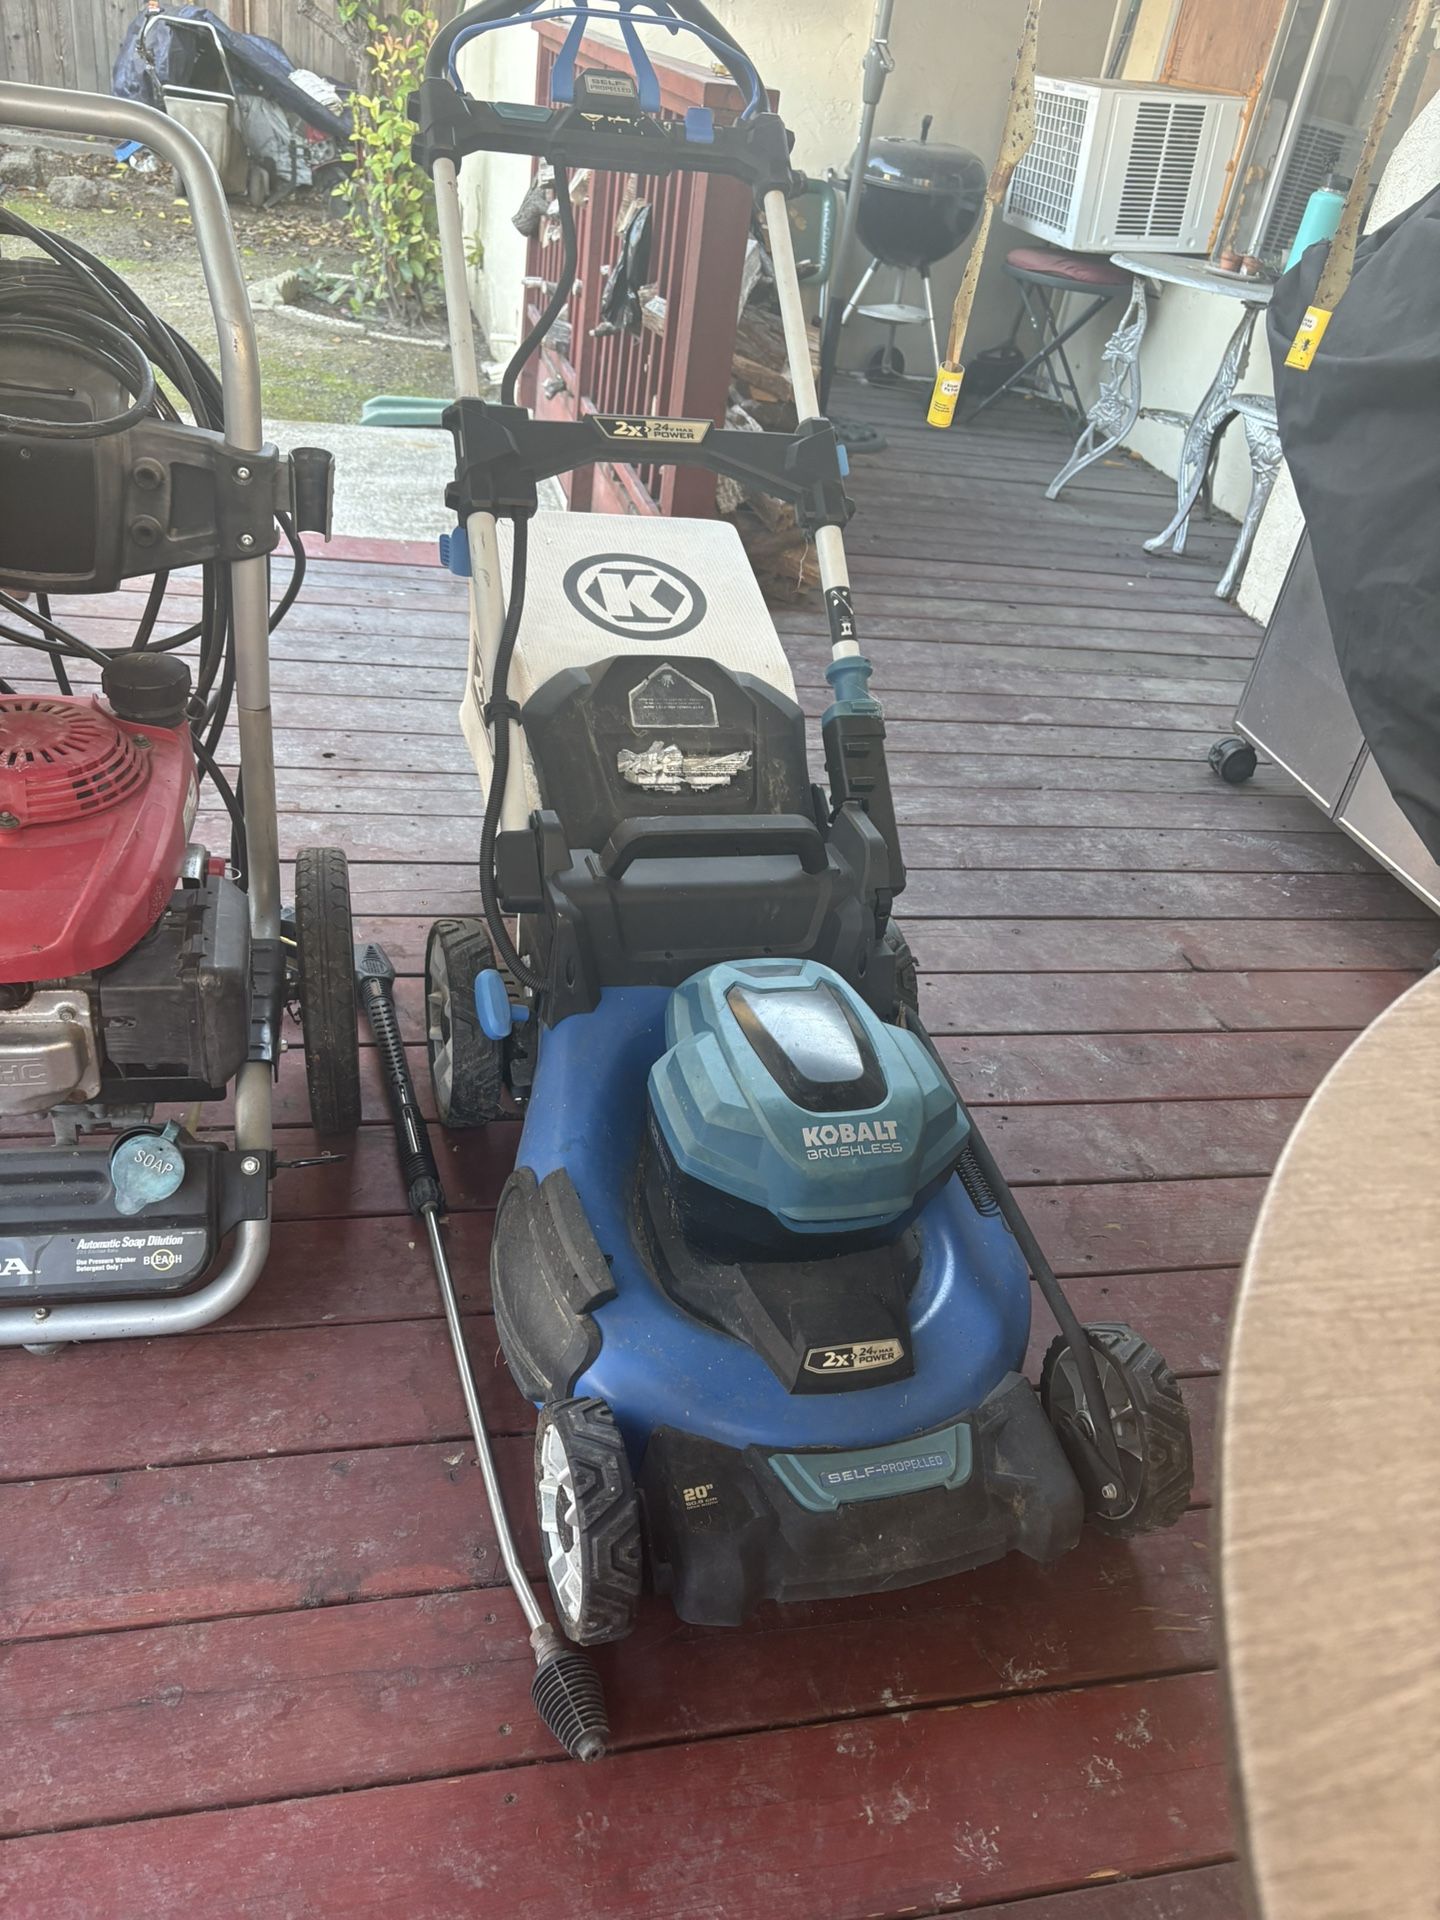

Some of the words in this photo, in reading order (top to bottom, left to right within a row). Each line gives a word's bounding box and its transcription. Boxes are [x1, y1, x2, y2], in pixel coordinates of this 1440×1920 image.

[590, 85, 632, 94] PROPELLED
[654, 432, 695, 440] POWER
[802, 1121, 898, 1147] KOBALT
[806, 1143, 903, 1160] BRUSHLESS
[133, 1149, 174, 1175] SOAP
[76, 1238, 121, 1251] Automatic
[121, 1236, 146, 1249] Soap
[146, 1234, 184, 1247] Dilution
[88, 1258, 114, 1266] Pressure
[114, 1256, 137, 1264] Washer
[143, 1254, 183, 1266] BLEACH
[76, 1265, 105, 1273] Detergent
[105, 1264, 119, 1272] Only
[859, 1352, 895, 1364] POWER
[827, 1455, 943, 1483] SELF-PROPELLED
